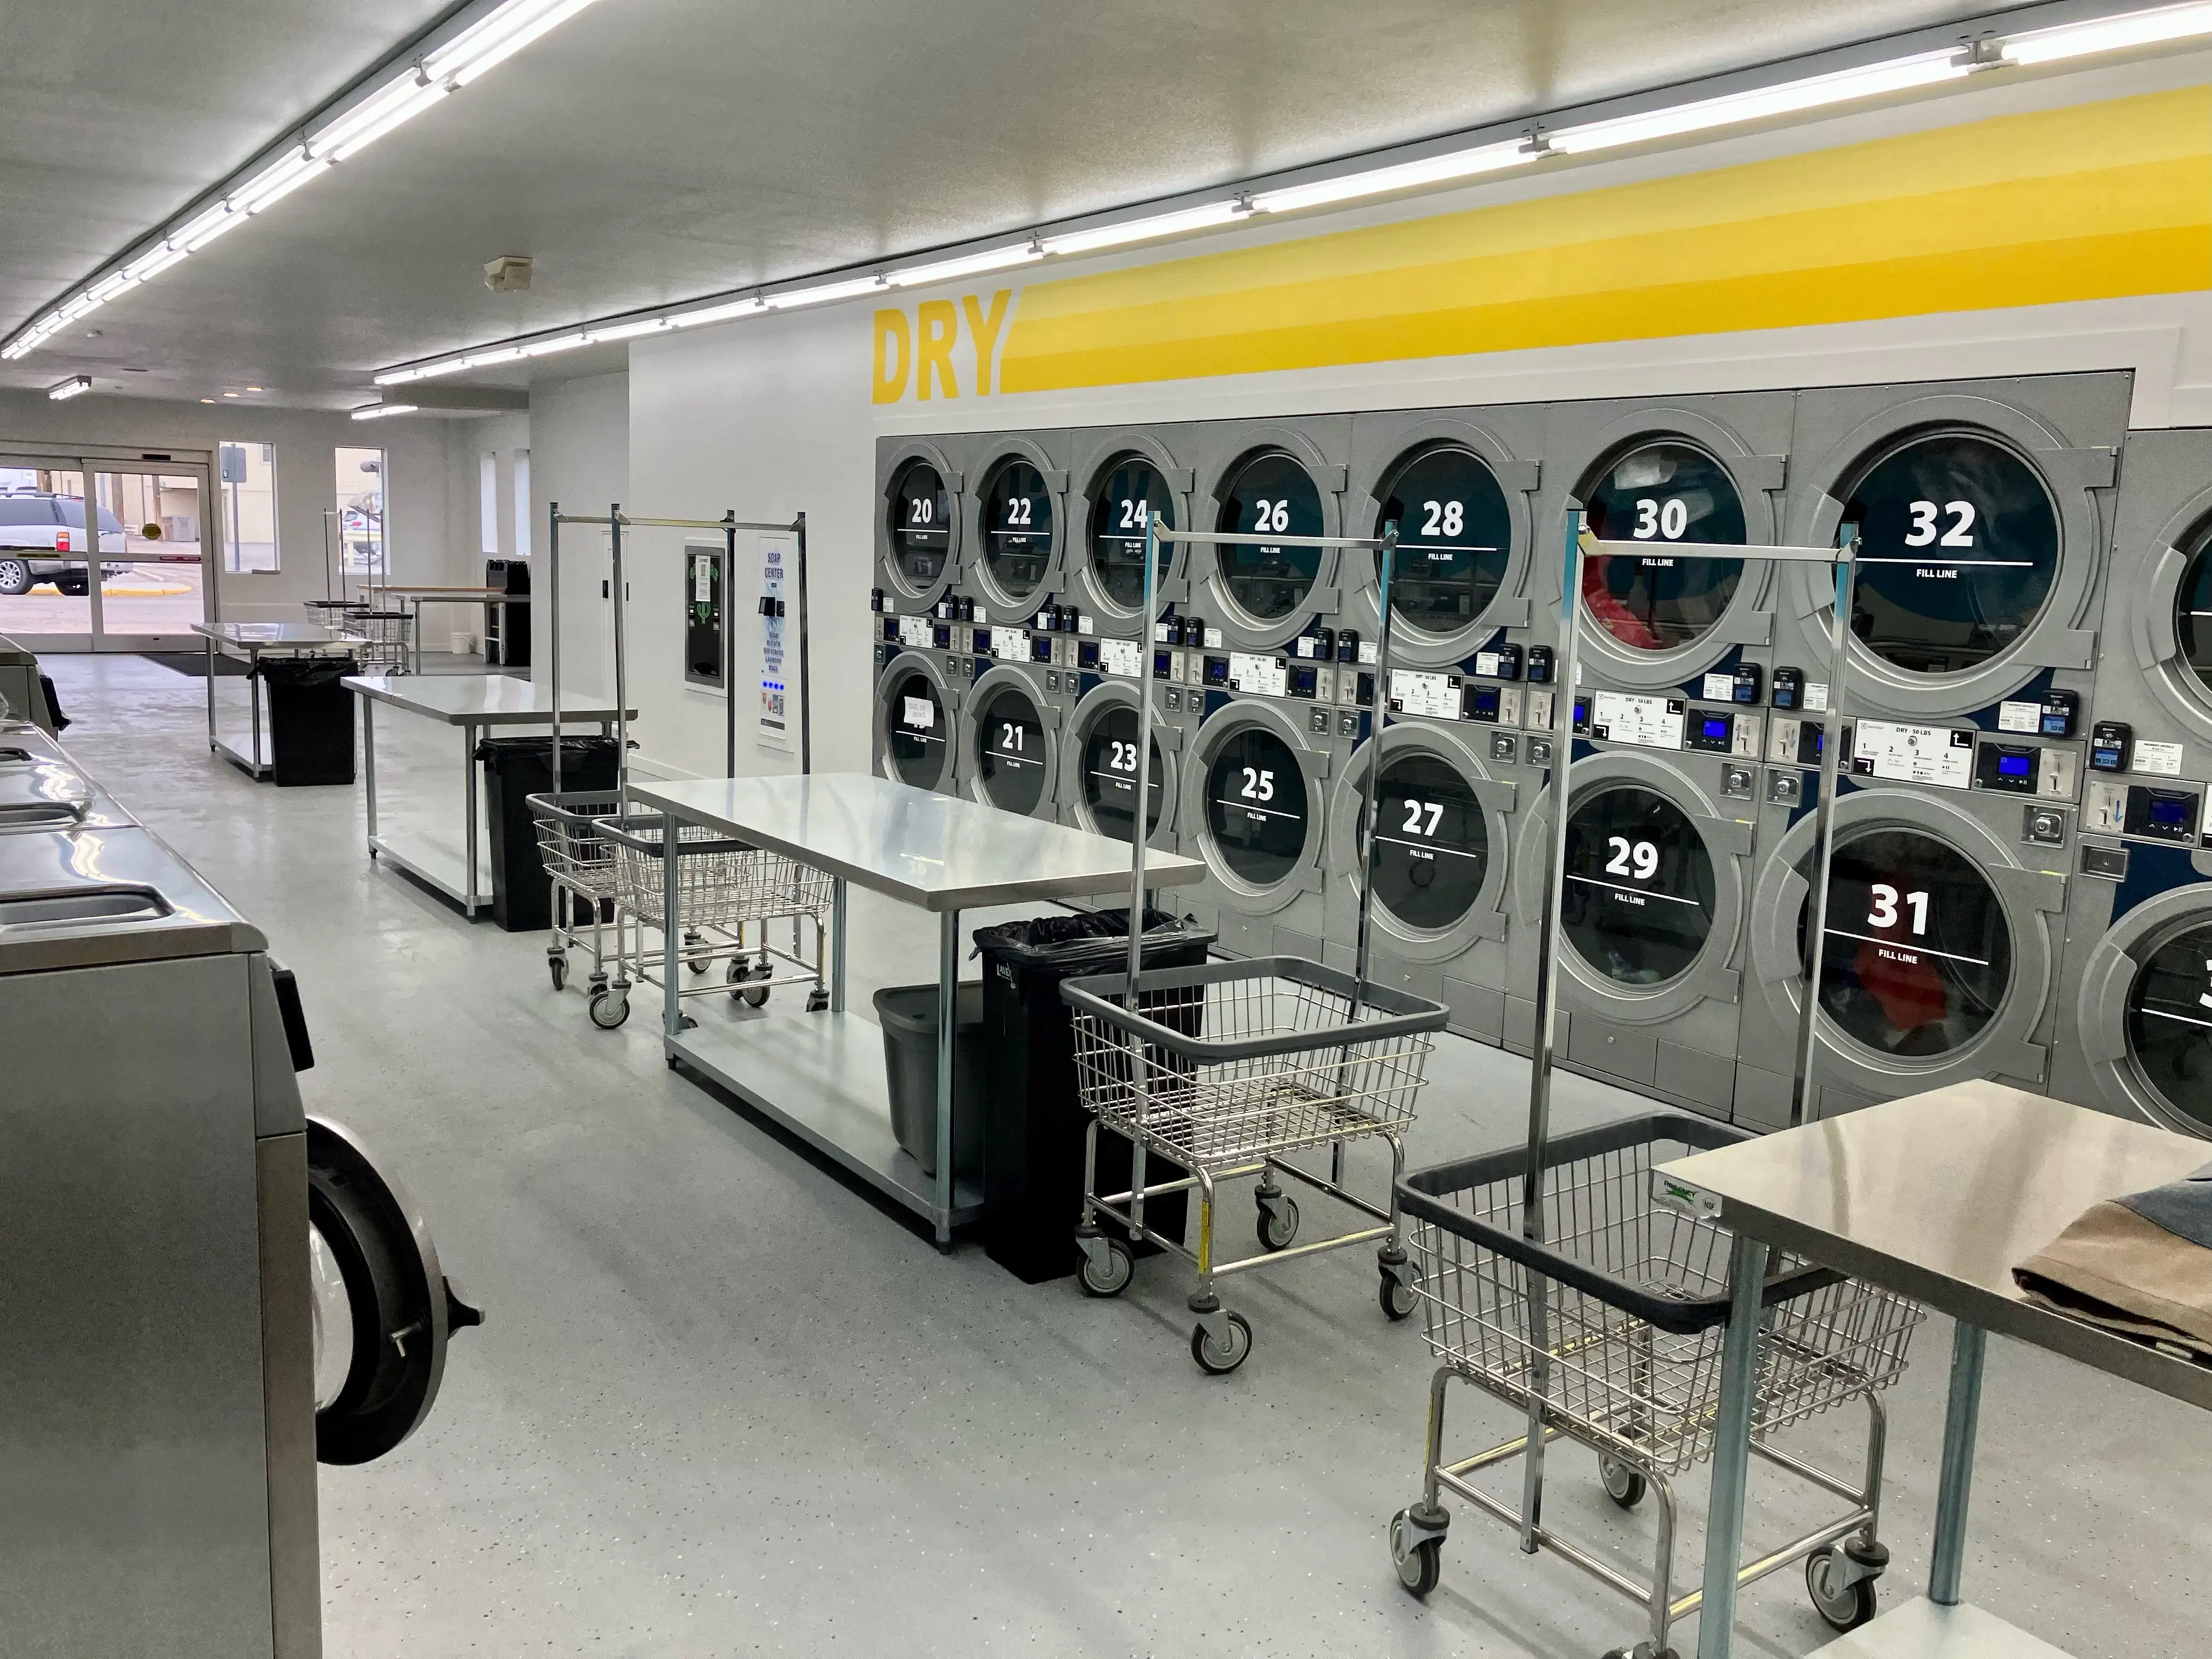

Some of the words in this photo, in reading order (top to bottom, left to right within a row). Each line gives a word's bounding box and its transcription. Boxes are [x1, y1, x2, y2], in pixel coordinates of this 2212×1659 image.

[873, 289, 1012, 405] DRY
[912, 499, 932, 523] 20
[1008, 498, 1030, 524] 22
[1120, 500, 1147, 528] 24
[1255, 500, 1288, 532] 26
[1421, 501, 1463, 536] 28
[1633, 499, 1687, 539] 30
[1905, 501, 1974, 546] 32
[768, 553, 780, 563] SOAP
[765, 567, 783, 578] CENTER
[1917, 569, 1934, 577] FILL
[1937, 570, 1957, 579] LINE
[1003, 724, 1022, 751] 21
[1111, 742, 1136, 771] 23
[1242, 768, 1273, 800] 25
[1403, 800, 1443, 836] 27
[1421, 851, 1434, 860] LINE
[1606, 837, 1658, 878] 29
[1615, 893, 1629, 902] FILL
[1630, 896, 1645, 906] LINE
[1867, 884, 1928, 935] 31
[1879, 949, 1896, 959] FILL
[1898, 952, 1918, 964] LINE
[1664, 1181, 1696, 1197] REGENCY
[1704, 1200, 1715, 1210] NSF
